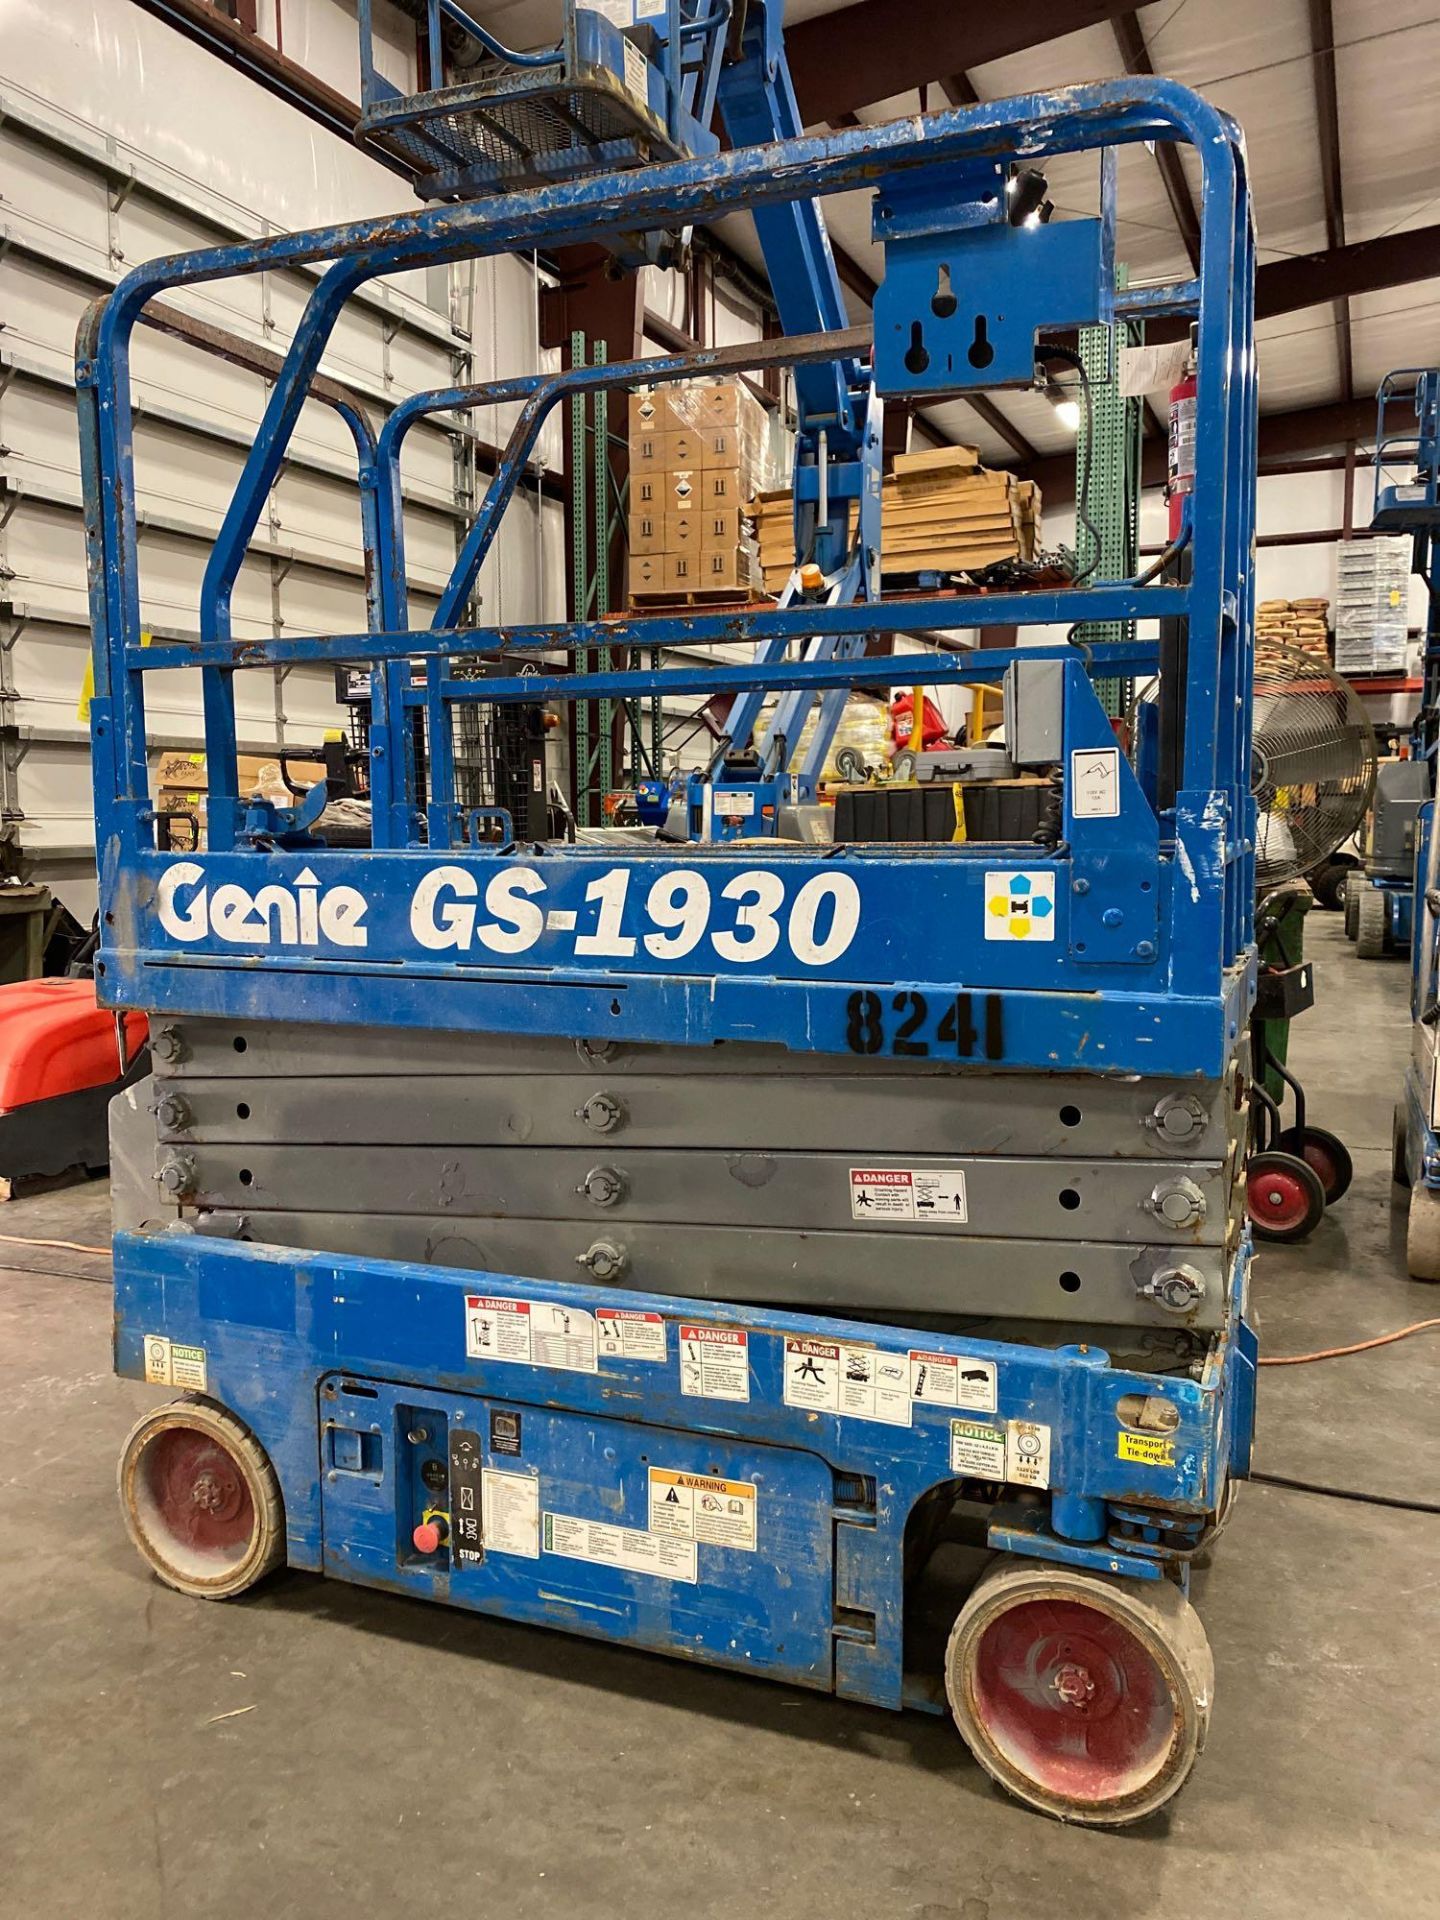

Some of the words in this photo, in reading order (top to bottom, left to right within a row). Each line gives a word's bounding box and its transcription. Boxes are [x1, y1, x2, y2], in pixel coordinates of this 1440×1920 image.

[157, 862, 369, 947] Genie
[410, 866, 861, 966] GS-1930
[846, 990, 1004, 1060] 8241
[863, 1174, 909, 1184] DANGER
[485, 1301, 518, 1311] DANGER
[620, 1312, 646, 1321] DANGER
[698, 1331, 740, 1344] DANGER
[172, 1347, 203, 1360] NOTICE
[801, 1342, 837, 1358] DANGER
[922, 1354, 952, 1365] DANGER
[954, 1422, 1002, 1442] NOTICE
[1125, 1435, 1167, 1448] Transport
[686, 1478, 727, 1492] WARNING
[459, 1549, 481, 1562] STOP
